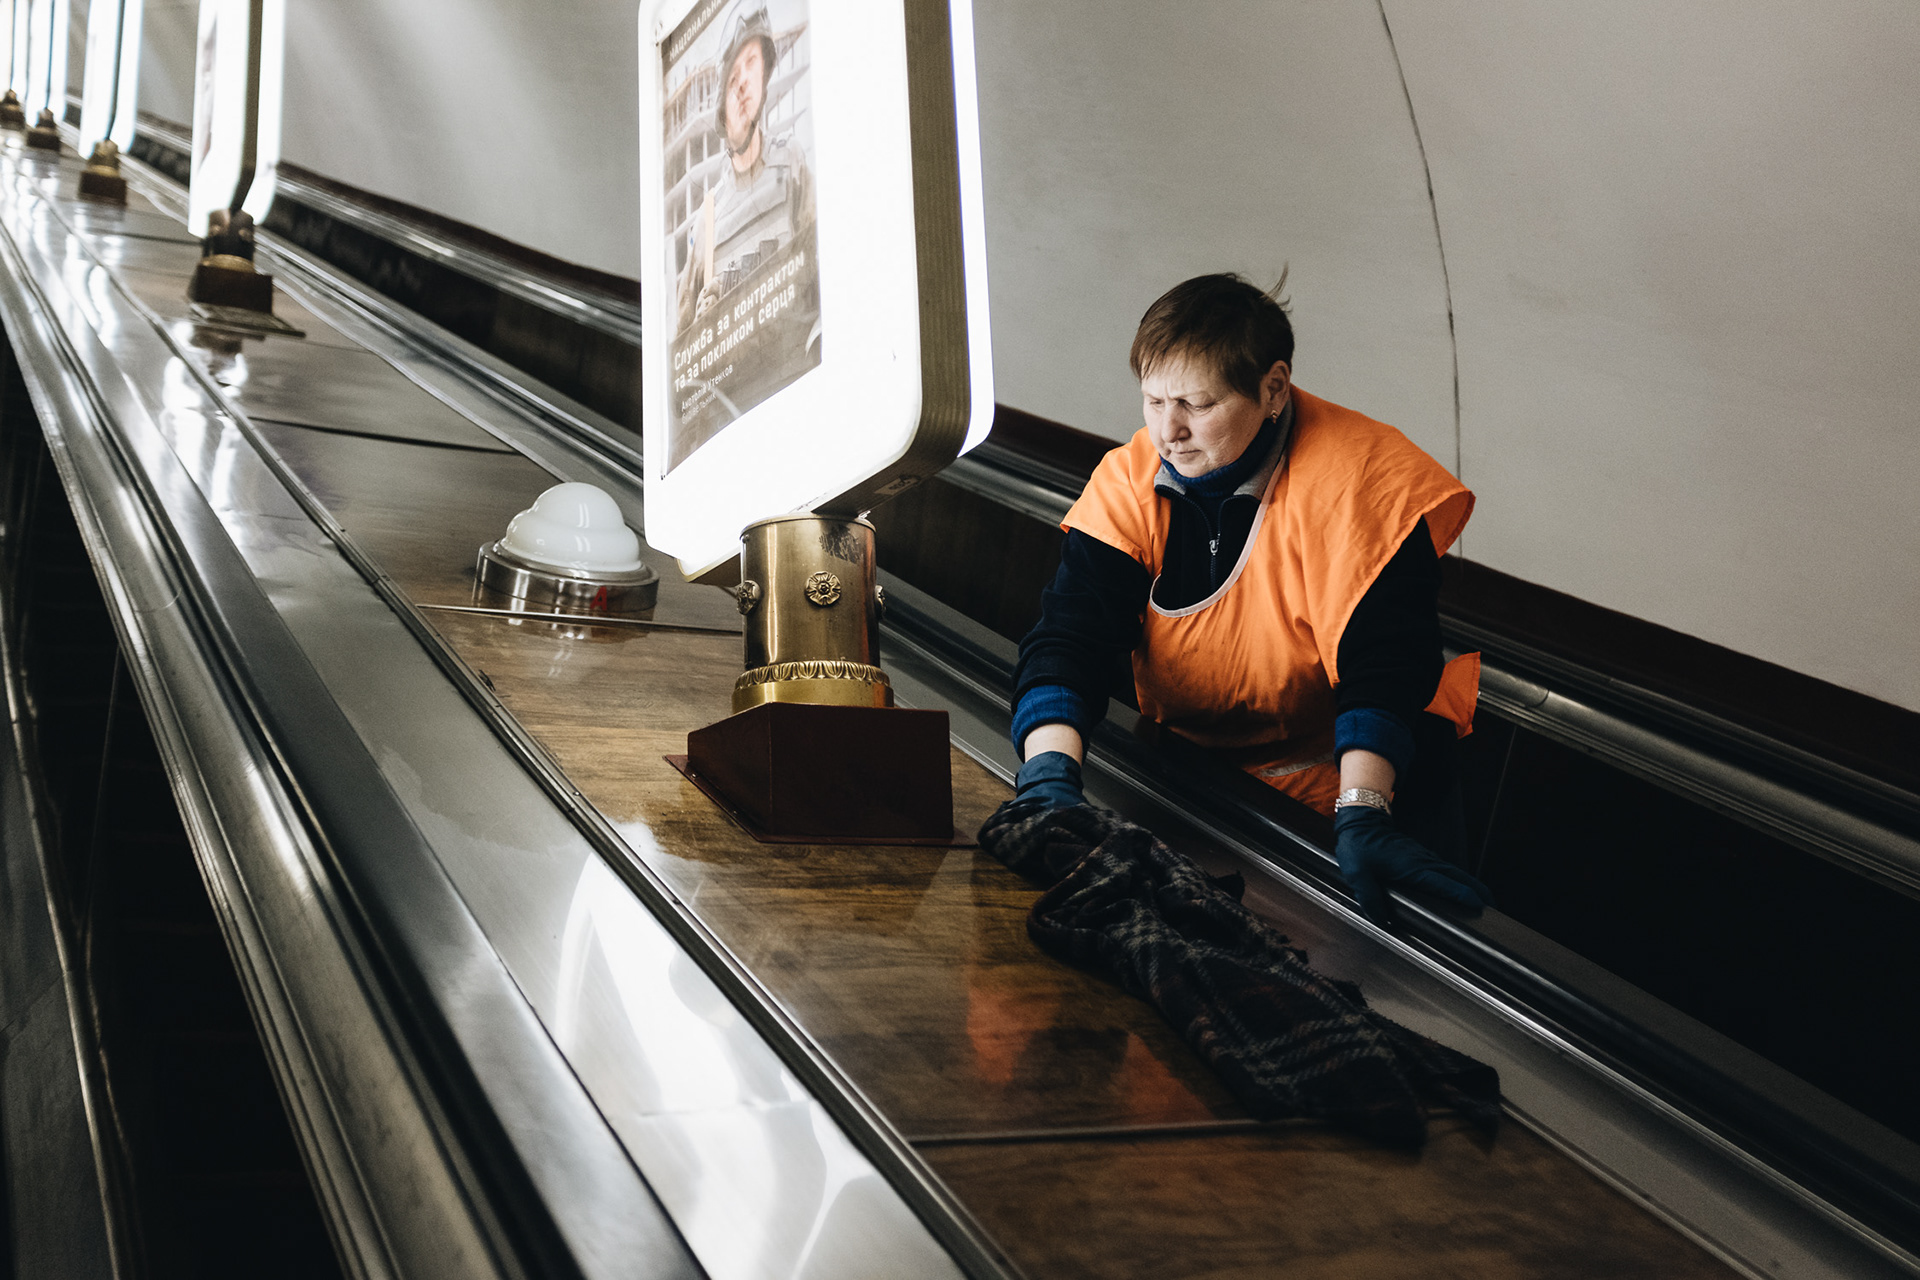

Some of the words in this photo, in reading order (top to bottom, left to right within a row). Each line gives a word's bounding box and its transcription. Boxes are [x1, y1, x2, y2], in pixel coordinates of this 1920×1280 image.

[674, 328, 713, 371] Служба
[717, 315, 730, 336] за
[734, 251, 805, 321] контрактом
[675, 373, 686, 393] та
[687, 362, 699, 383] за
[701, 317, 754, 372] покликом
[758, 284, 795, 324] серця
